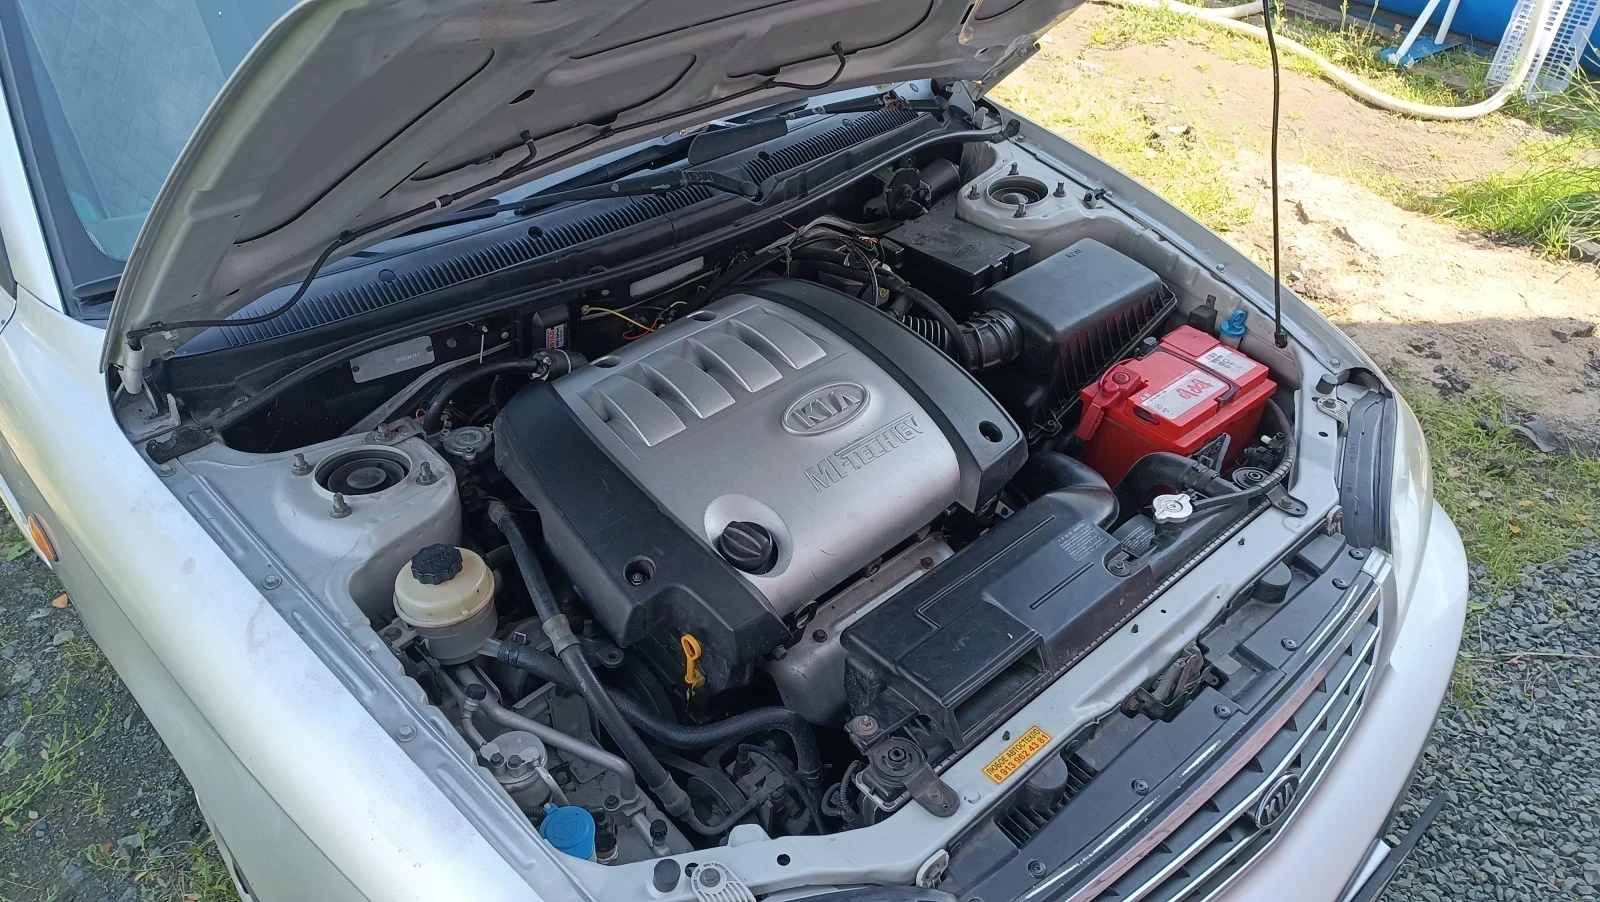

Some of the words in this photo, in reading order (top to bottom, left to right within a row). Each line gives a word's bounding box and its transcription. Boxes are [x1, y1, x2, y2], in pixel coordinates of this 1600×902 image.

[791, 391, 861, 429] KIA
[986, 755, 1009, 775] ЛЮБОЕ
[1006, 728, 1041, 759] АВТОСТЕКЛО
[994, 773, 1003, 781] 8
[1000, 761, 1017, 776] 913
[1013, 749, 1031, 764] 962
[1028, 741, 1040, 752] 43
[1036, 734, 1049, 744] 81
[1265, 782, 1296, 823] KIA
